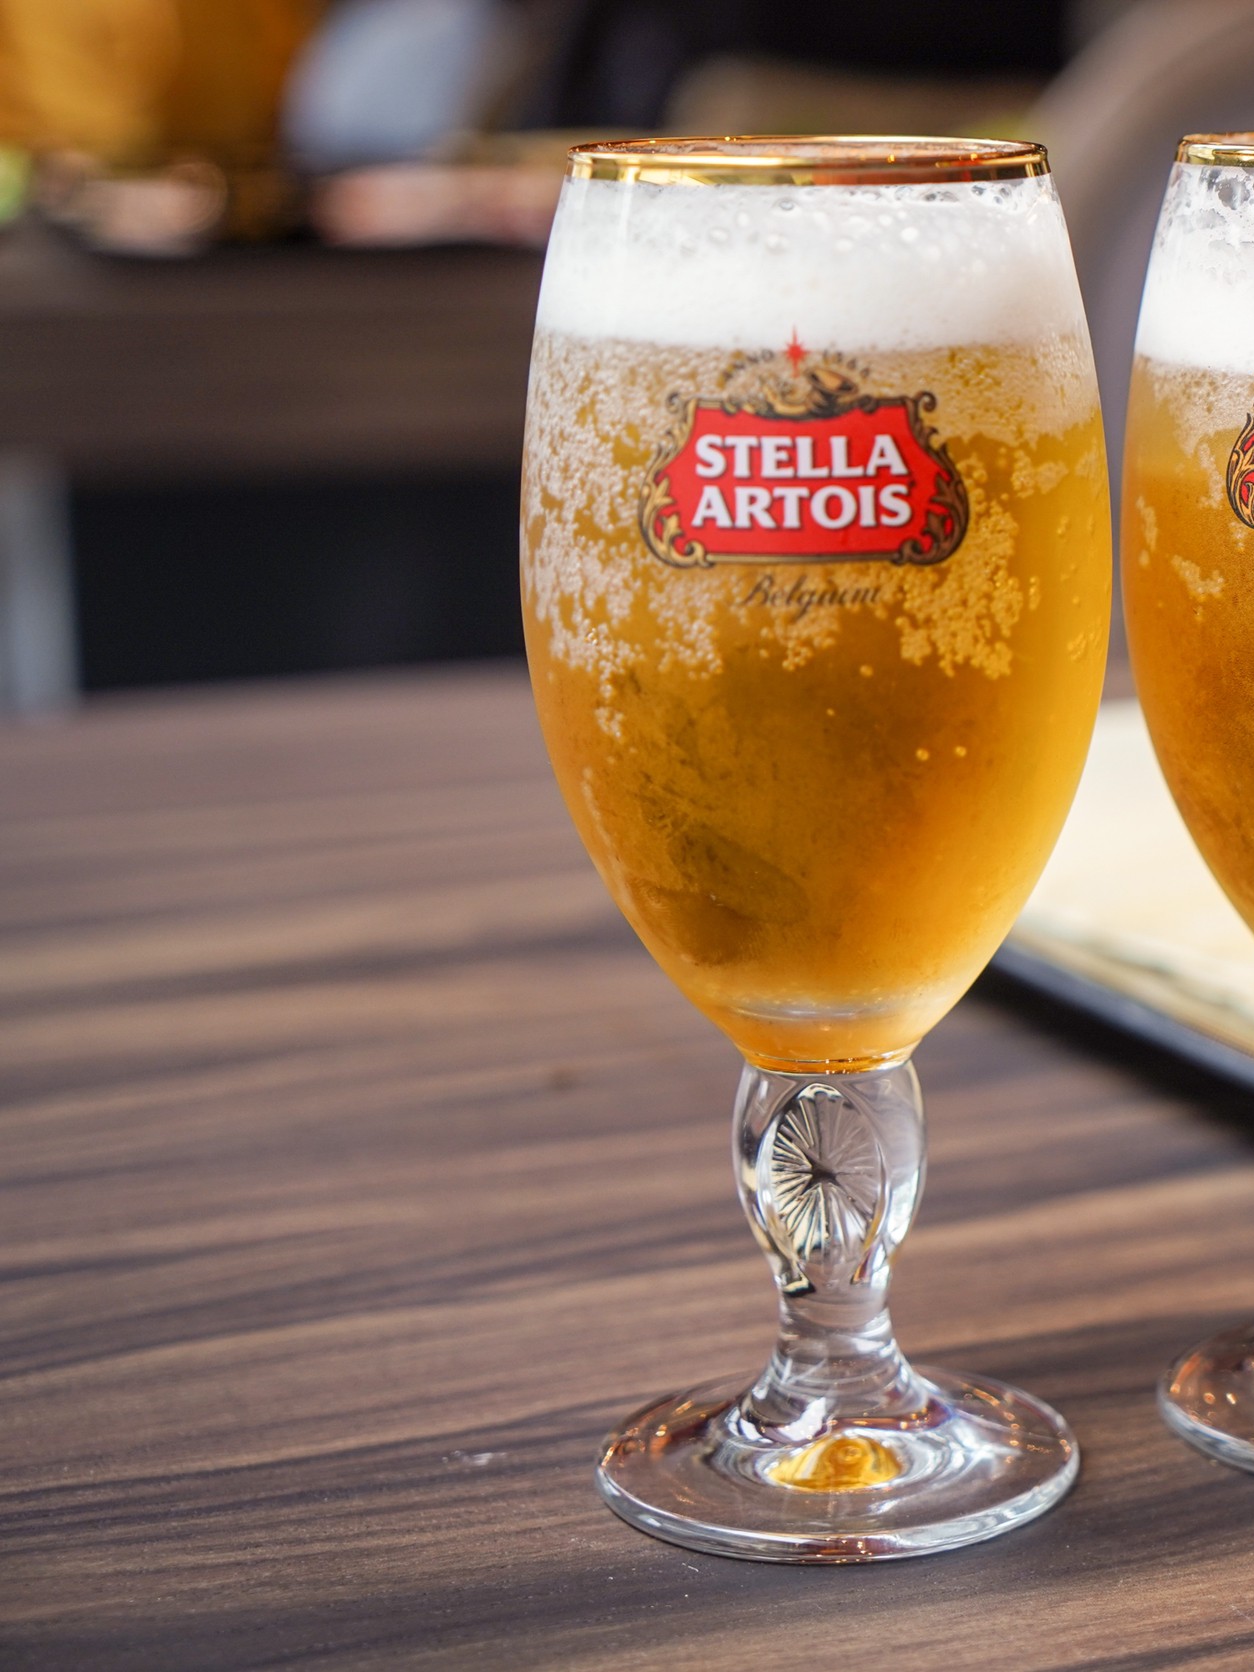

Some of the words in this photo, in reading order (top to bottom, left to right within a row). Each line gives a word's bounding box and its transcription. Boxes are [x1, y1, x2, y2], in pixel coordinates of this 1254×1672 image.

[695, 434, 908, 478] STELLA
[690, 483, 913, 530] ARTOIS
[739, 575, 881, 620] Belgium
